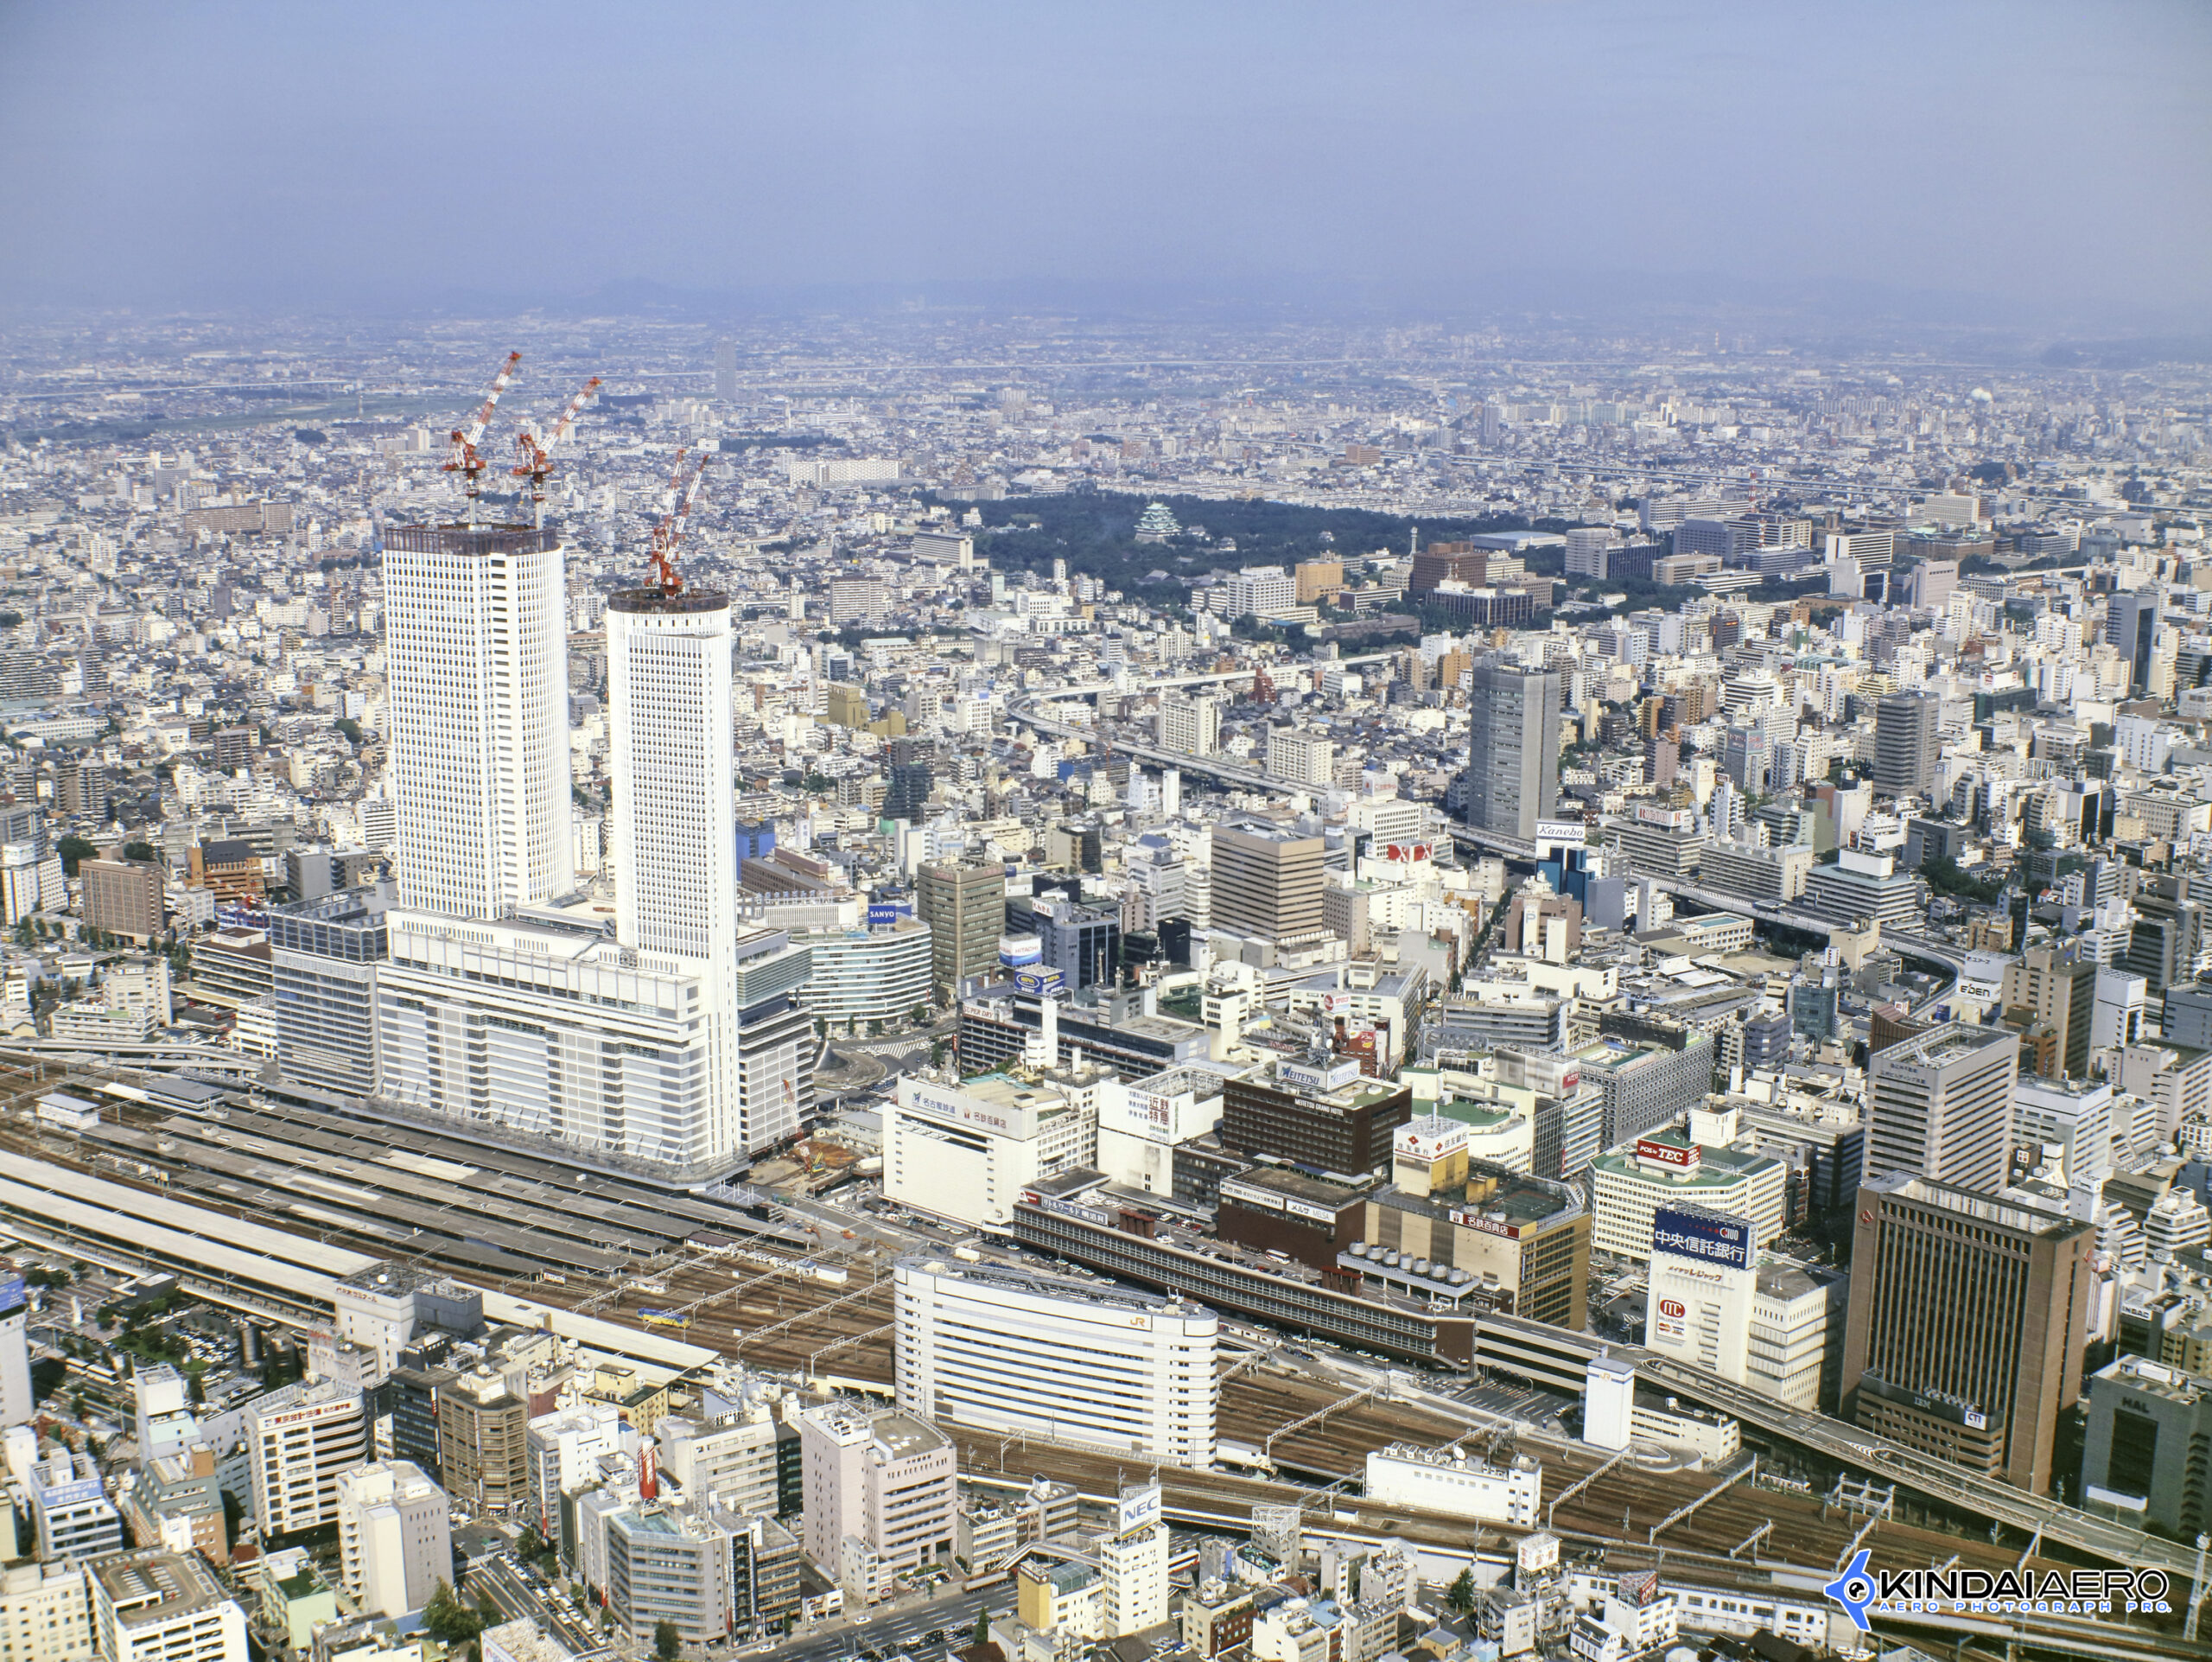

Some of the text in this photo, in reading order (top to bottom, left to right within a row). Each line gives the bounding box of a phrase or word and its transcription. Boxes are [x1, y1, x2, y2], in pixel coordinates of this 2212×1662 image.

[1538, 825, 1583, 836] Kanebo
[963, 1005, 994, 1019] SUPER DRY
[1295, 1098, 1344, 1117] MEITETSU GRAND HOTEL
[1658, 1148, 1684, 1162] TEC
[1291, 1204, 1310, 1214] メルサ
[1467, 1216, 1509, 1235] 名鉄百貨店
[1655, 1229, 1745, 1262] 中央信託銀行
[1130, 1316, 1145, 1327] JR
[1914, 1396, 1931, 1410] IBM
[2122, 1397, 2150, 1414] HAL
[1967, 1413, 1981, 1423] CTI
[1124, 1495, 1158, 1523] NEC
